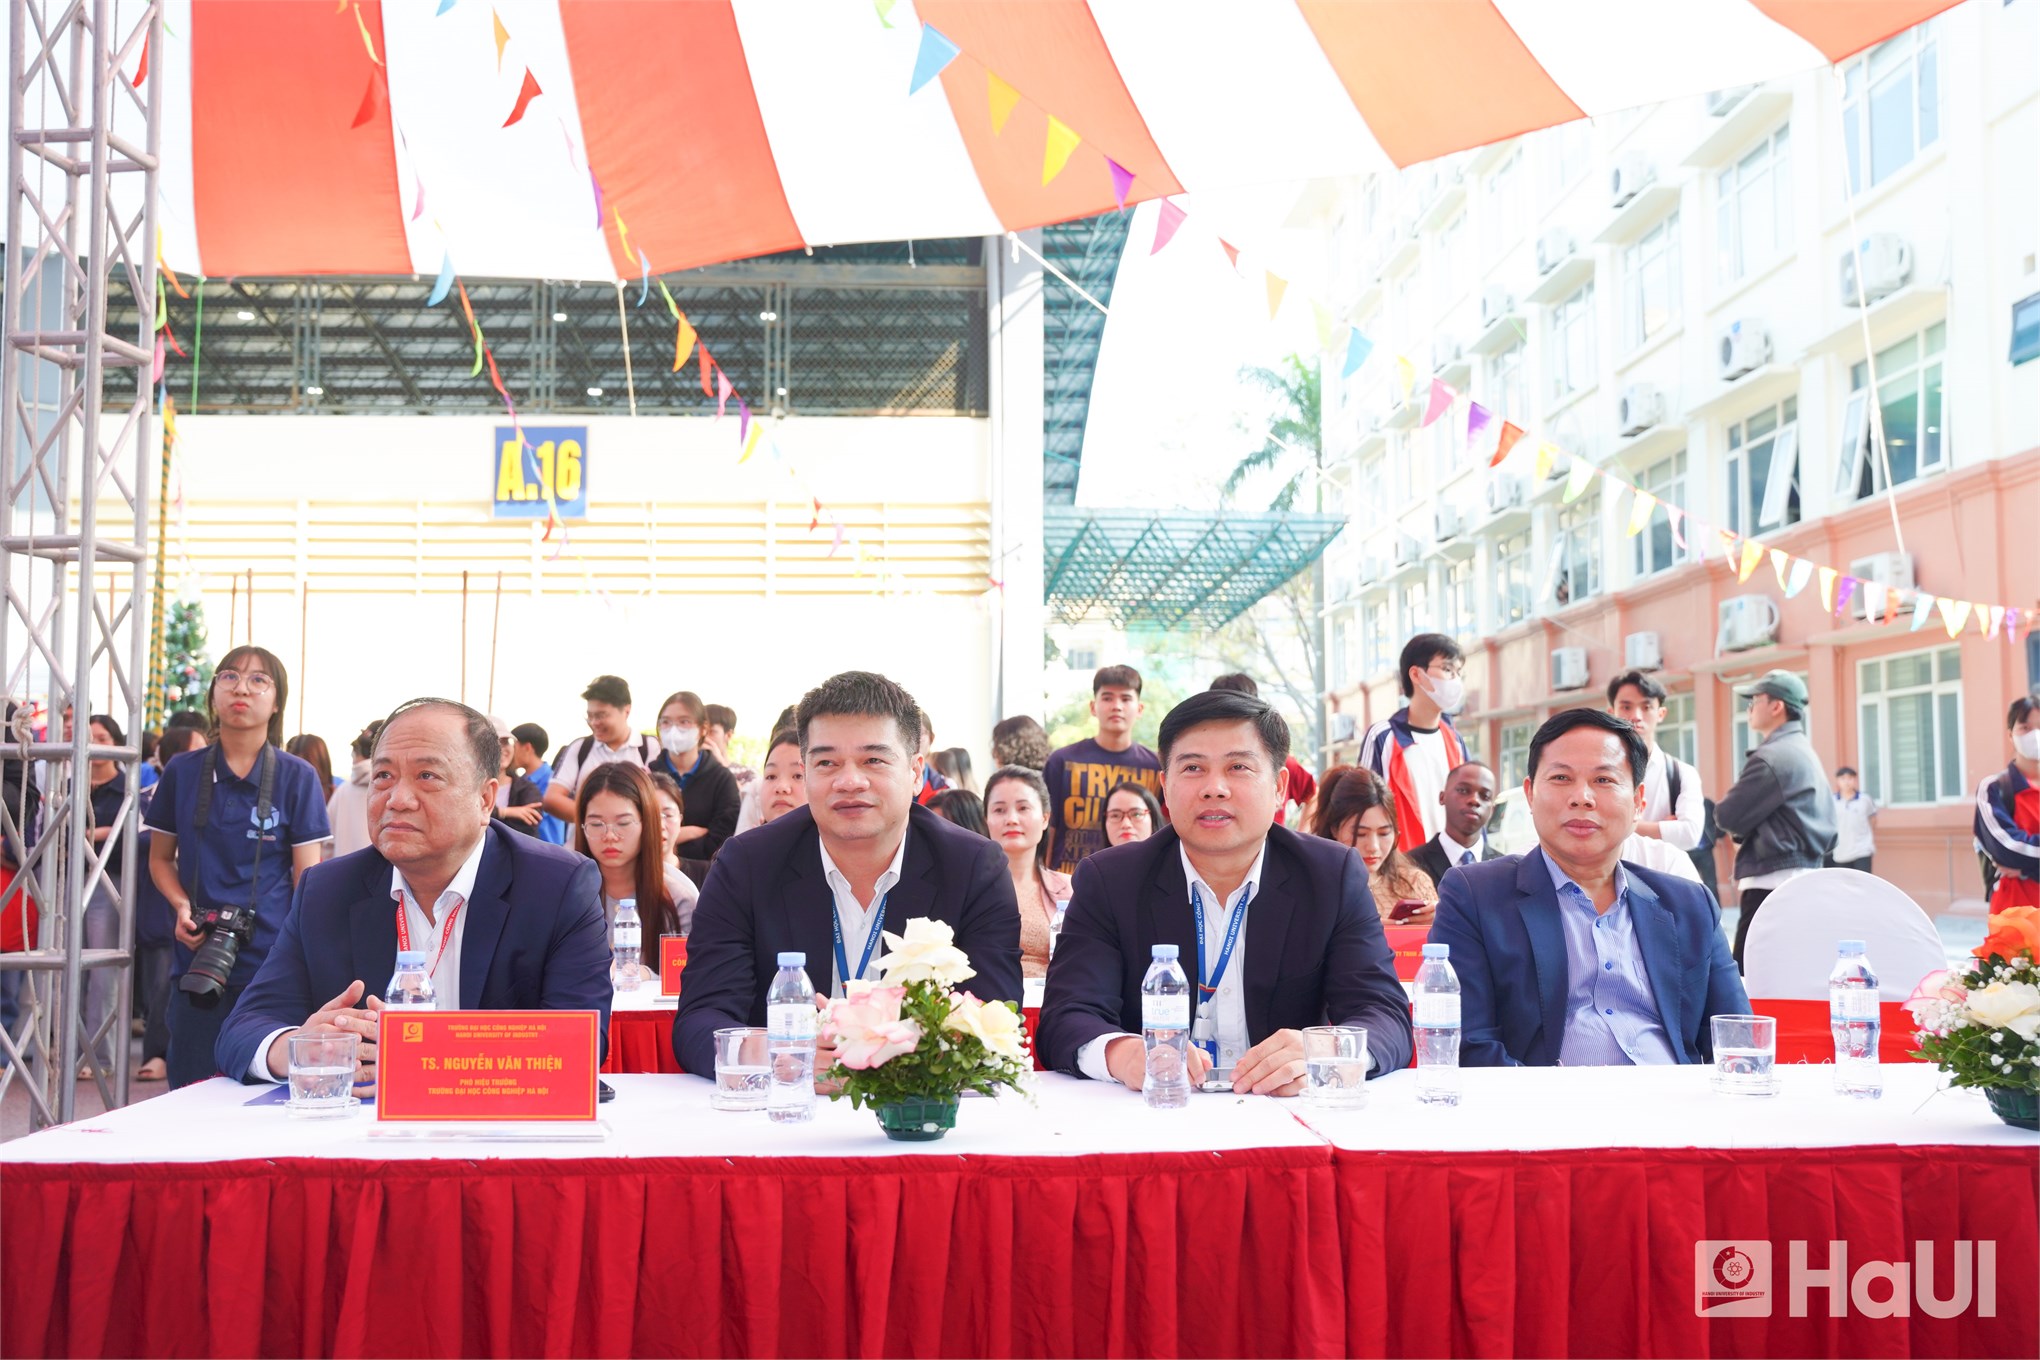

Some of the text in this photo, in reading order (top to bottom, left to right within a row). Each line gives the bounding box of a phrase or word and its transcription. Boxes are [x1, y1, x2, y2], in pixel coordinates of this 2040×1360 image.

[496, 439, 582, 501] A.16
[867, 932, 877, 950] HANOI
[1224, 936, 1233, 955] HANOI
[1230, 904, 1243, 936] UNIVERSITY
[421, 1053, 562, 1072] TS. NGUYỄN VĂN THIỆN
